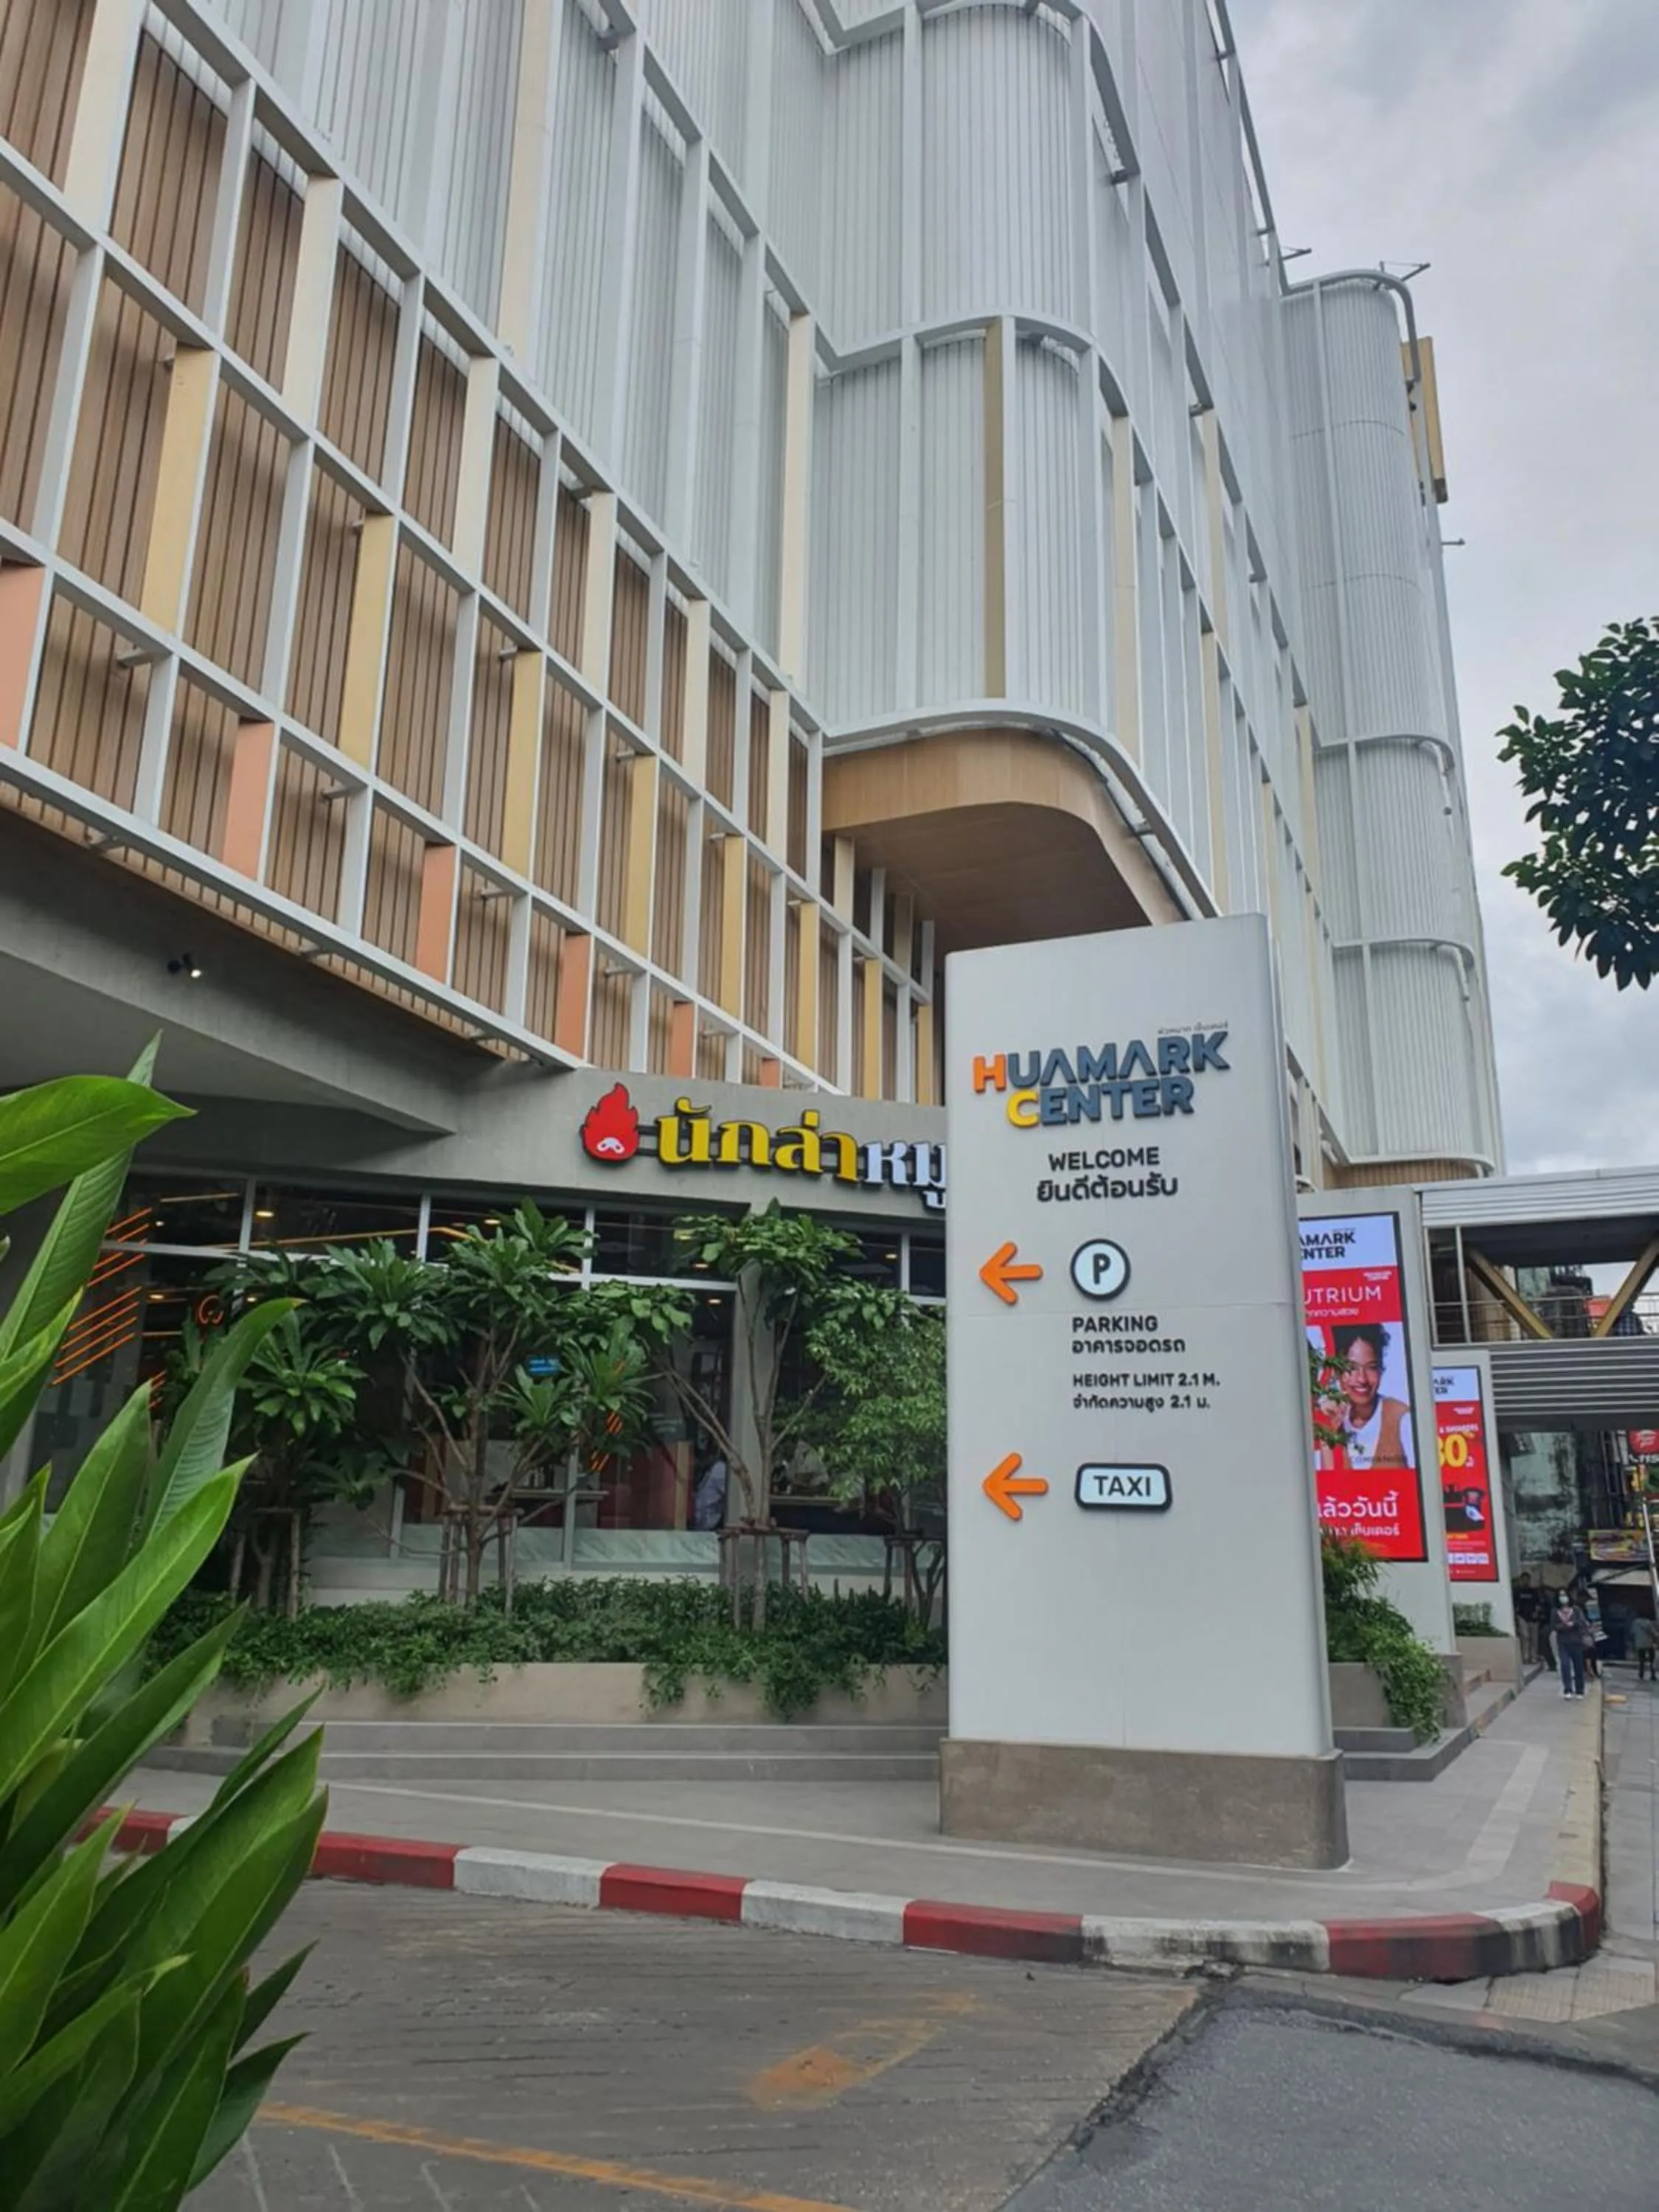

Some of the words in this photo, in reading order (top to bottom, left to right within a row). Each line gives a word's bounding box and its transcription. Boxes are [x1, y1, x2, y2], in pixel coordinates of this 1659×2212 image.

[973, 1030, 1231, 1094] HUAMARK
[1006, 1075, 1194, 1128] CENTER
[1048, 1147, 1161, 1171] WELCOME
[1037, 1172, 1178, 1203] ยินดีต้อนรับ
[1092, 1253, 1111, 1285] P
[1072, 1315, 1158, 1333] PARKING
[1072, 1338, 1186, 1354] อาคารจอดรถ
[1072, 1373, 1130, 1388] HEIGHT
[1133, 1373, 1175, 1387] LIMIT
[1178, 1372, 1200, 1386] 2.1
[1203, 1372, 1221, 1386] M.
[1072, 1393, 1165, 1413] จำกัดความสูง
[1170, 1394, 1192, 1409] 2.1
[1196, 1397, 1211, 1409] ม.
[1093, 1475, 1152, 1498] TAXI
